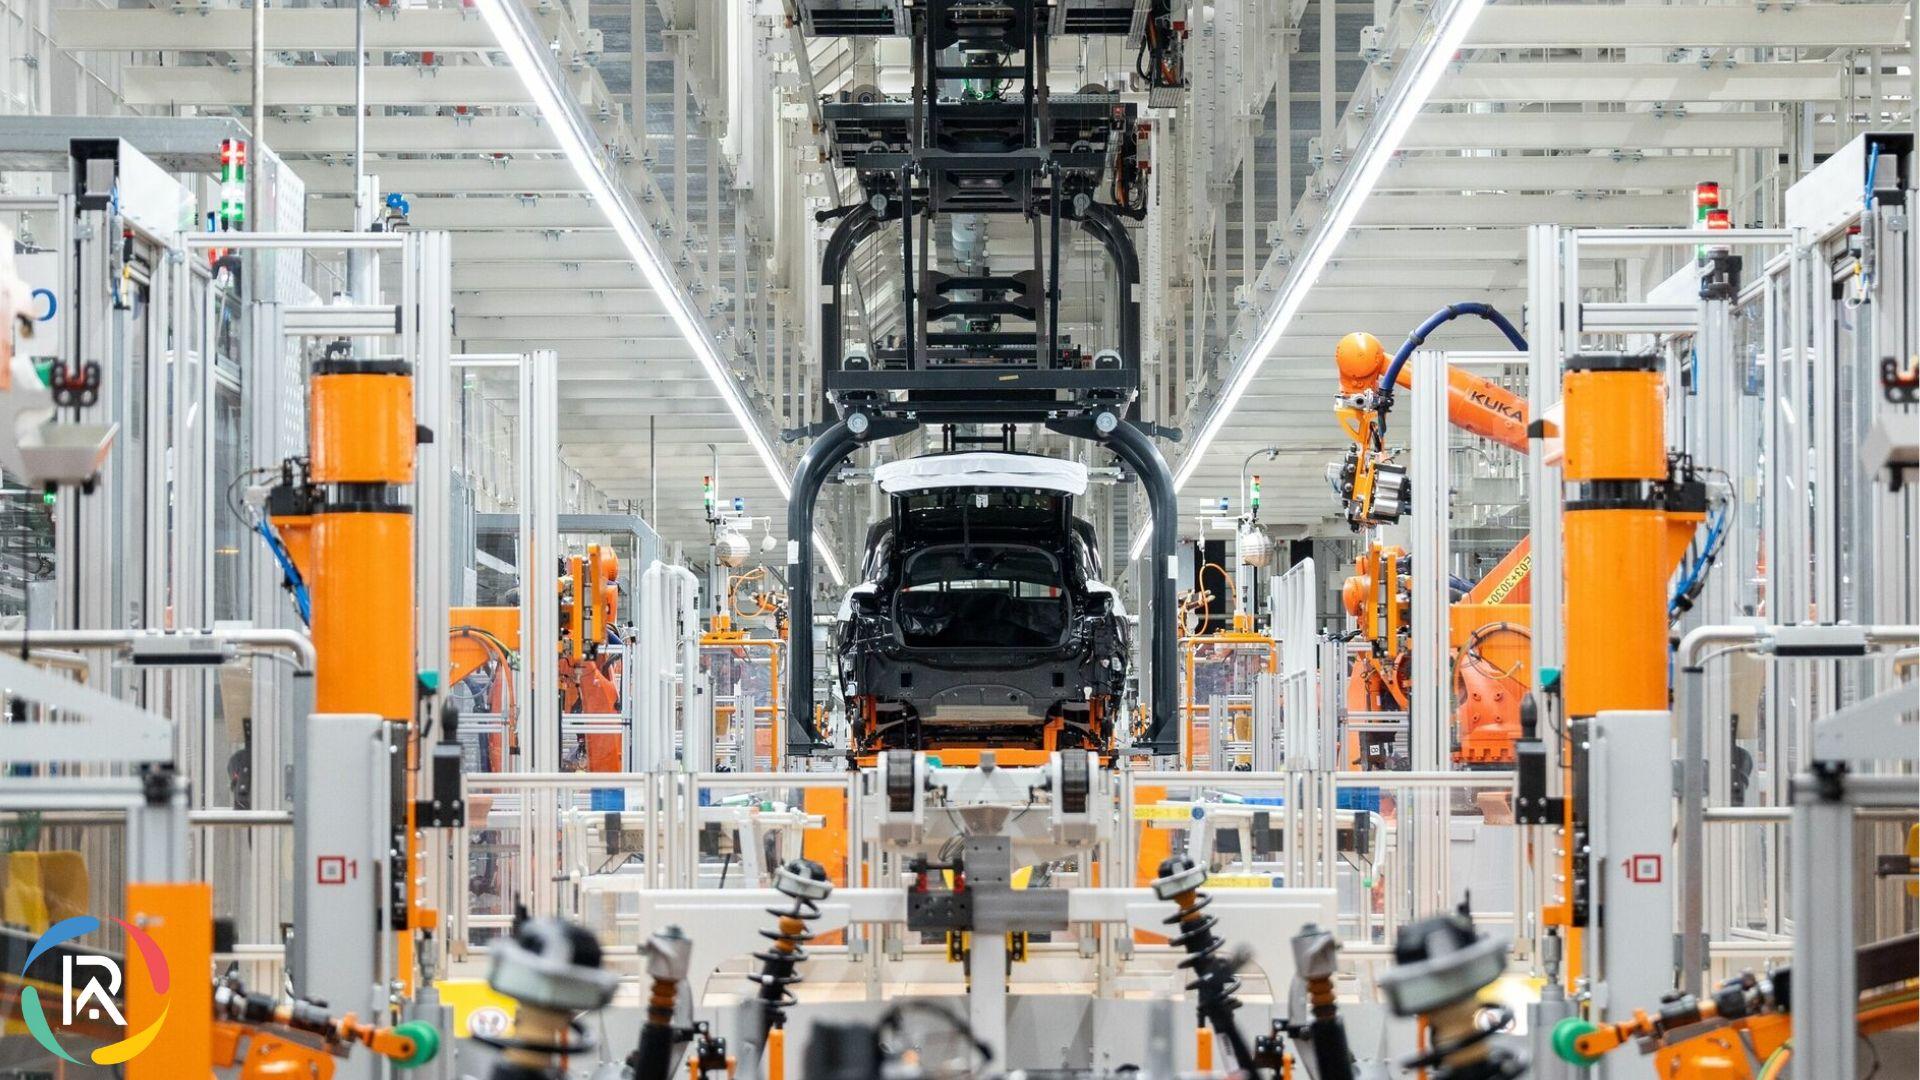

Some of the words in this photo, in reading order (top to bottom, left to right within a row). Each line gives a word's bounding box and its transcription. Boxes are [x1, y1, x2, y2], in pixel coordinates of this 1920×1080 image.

[1470, 391, 1522, 422] KUKA
[347, 859, 357, 880] 1
[1620, 859, 1630, 879] 1
